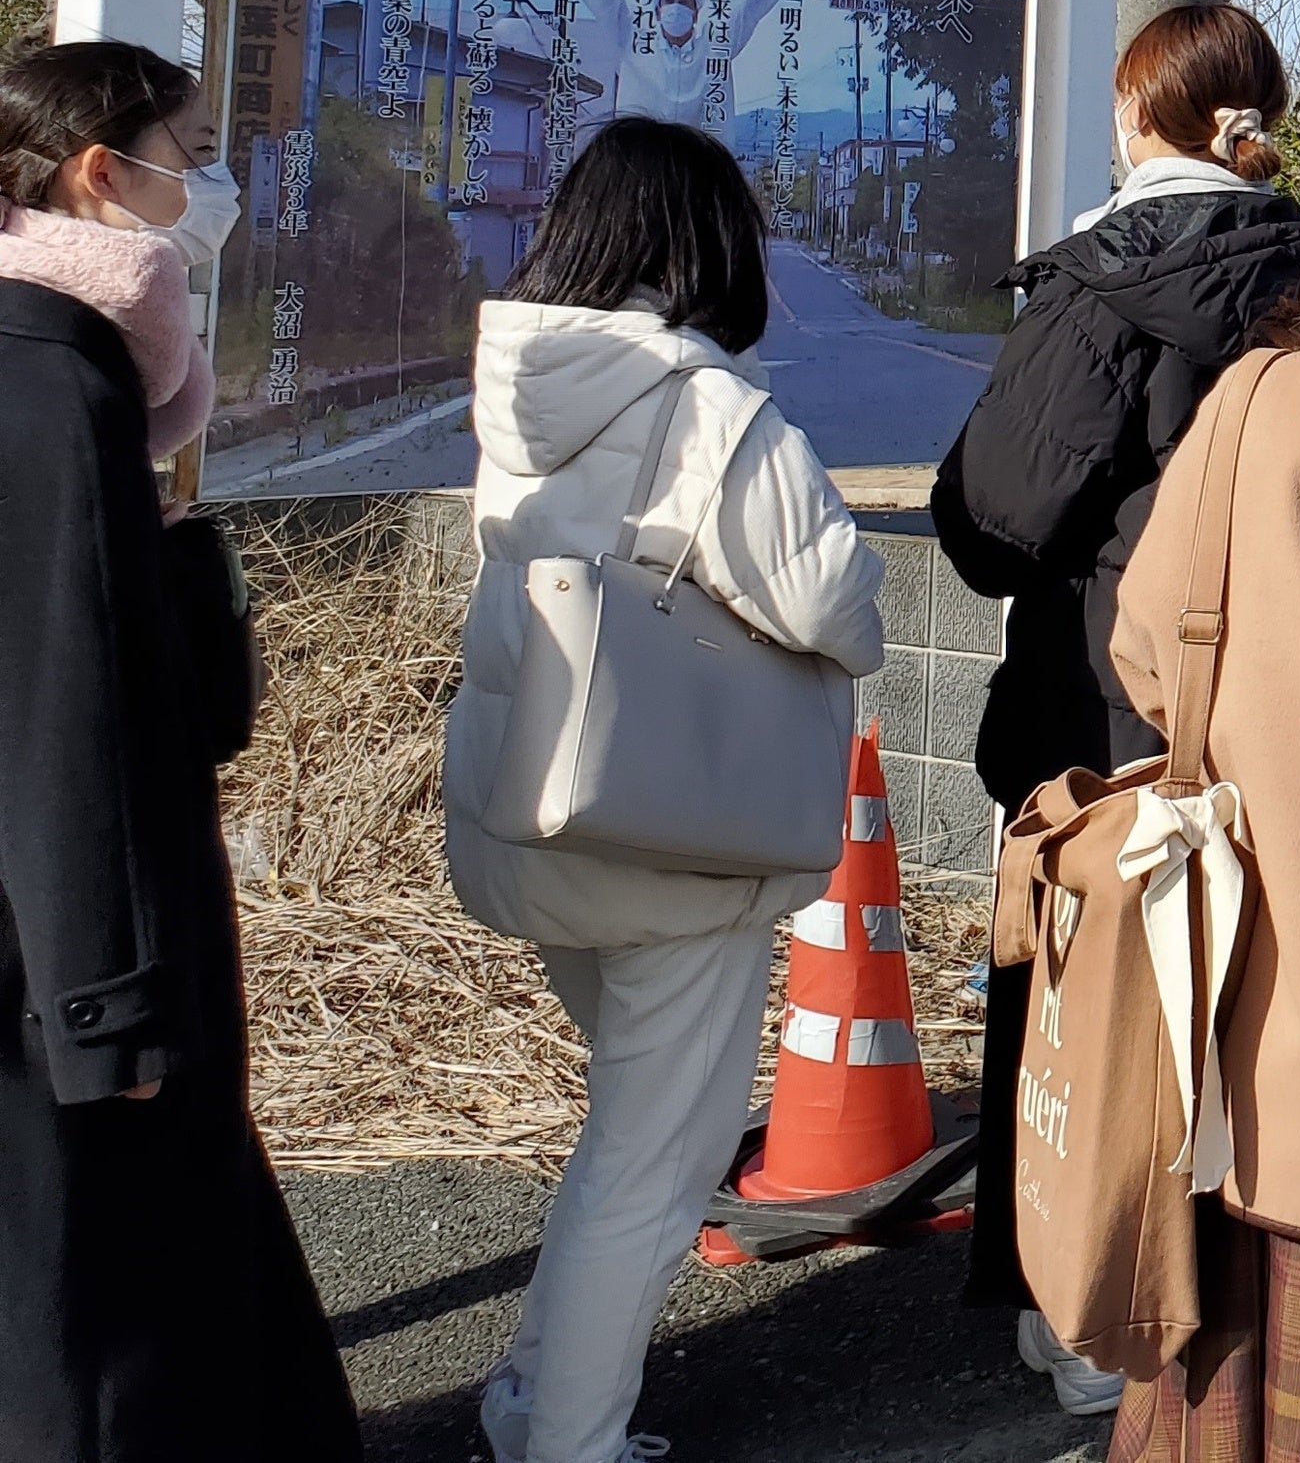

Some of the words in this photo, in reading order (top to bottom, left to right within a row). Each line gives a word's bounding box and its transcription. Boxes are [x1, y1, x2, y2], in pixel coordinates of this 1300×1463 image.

[278, 130, 314, 238] 震災3年
[462, 107, 494, 205] 懐かしい
[273, 281, 305, 340] 大沼
[269, 346, 299, 405] 勇治
